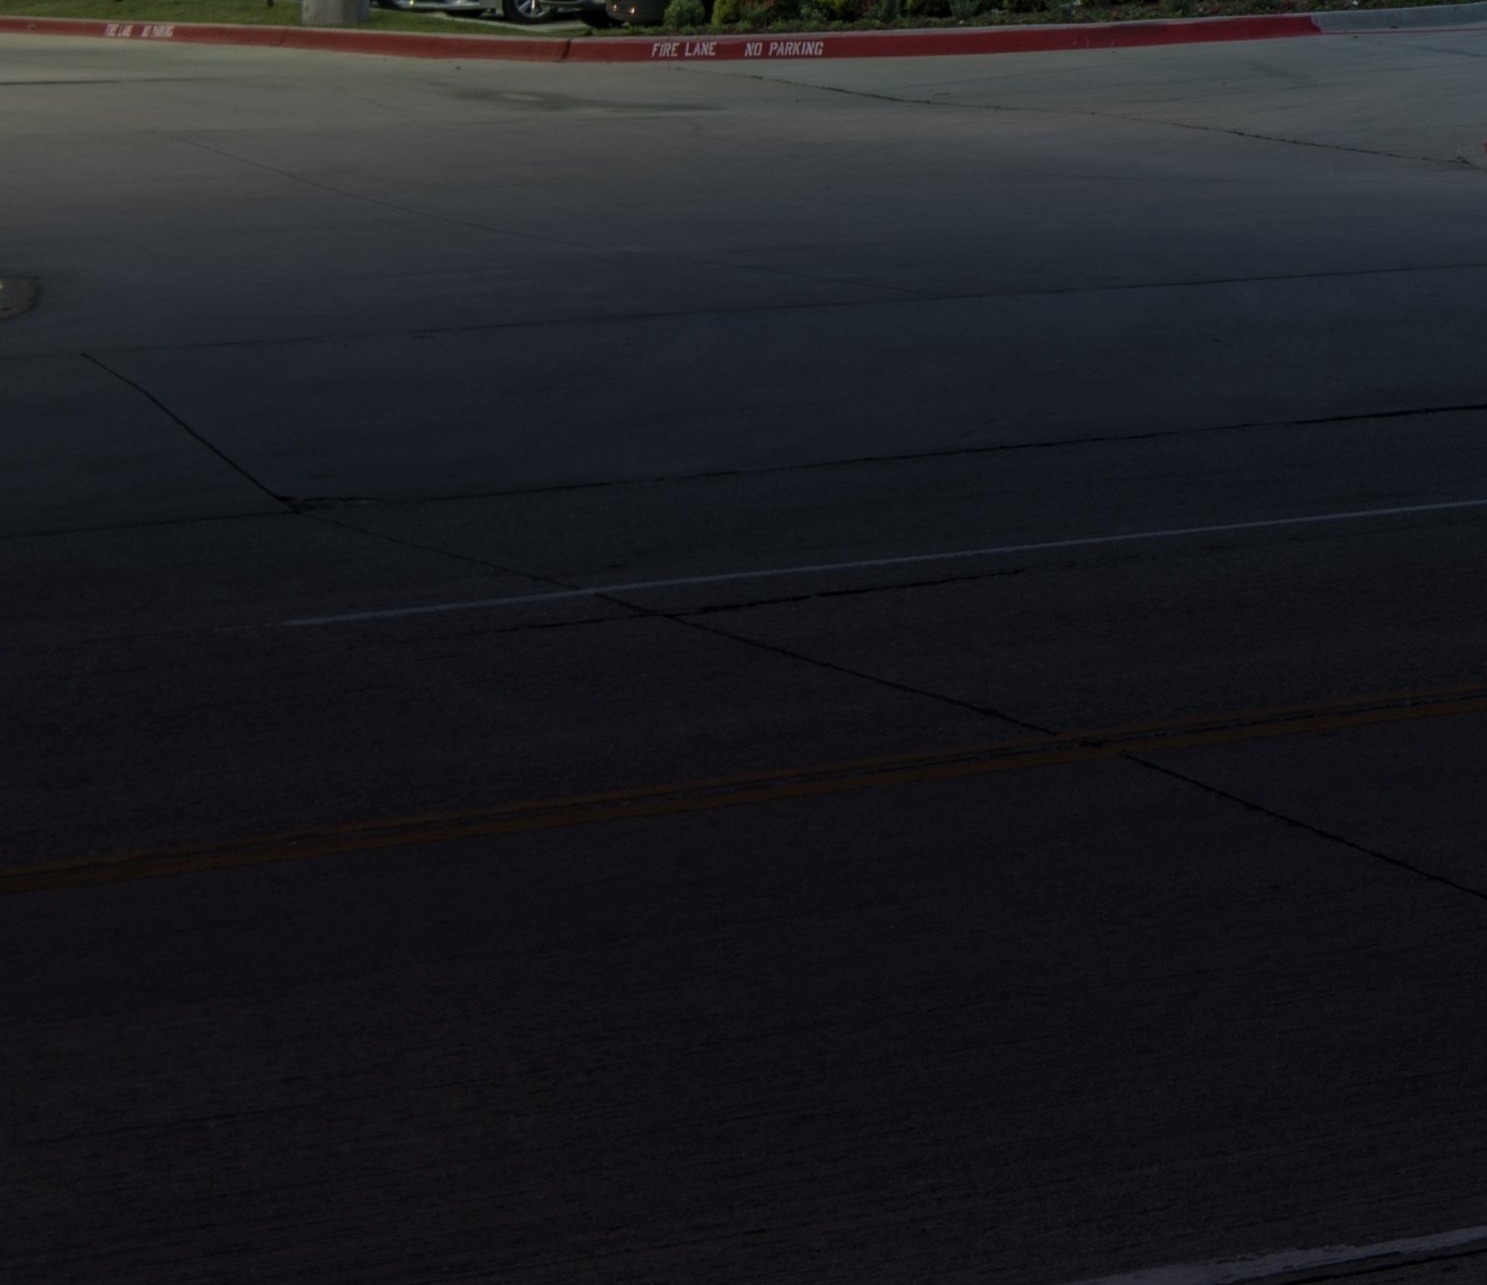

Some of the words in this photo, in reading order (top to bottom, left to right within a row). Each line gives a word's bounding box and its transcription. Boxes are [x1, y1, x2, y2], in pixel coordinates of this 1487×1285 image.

[651, 42, 680, 57] FIRE
[684, 41, 718, 57] LANE
[743, 41, 763, 57] NO
[768, 41, 825, 57] PARKING
